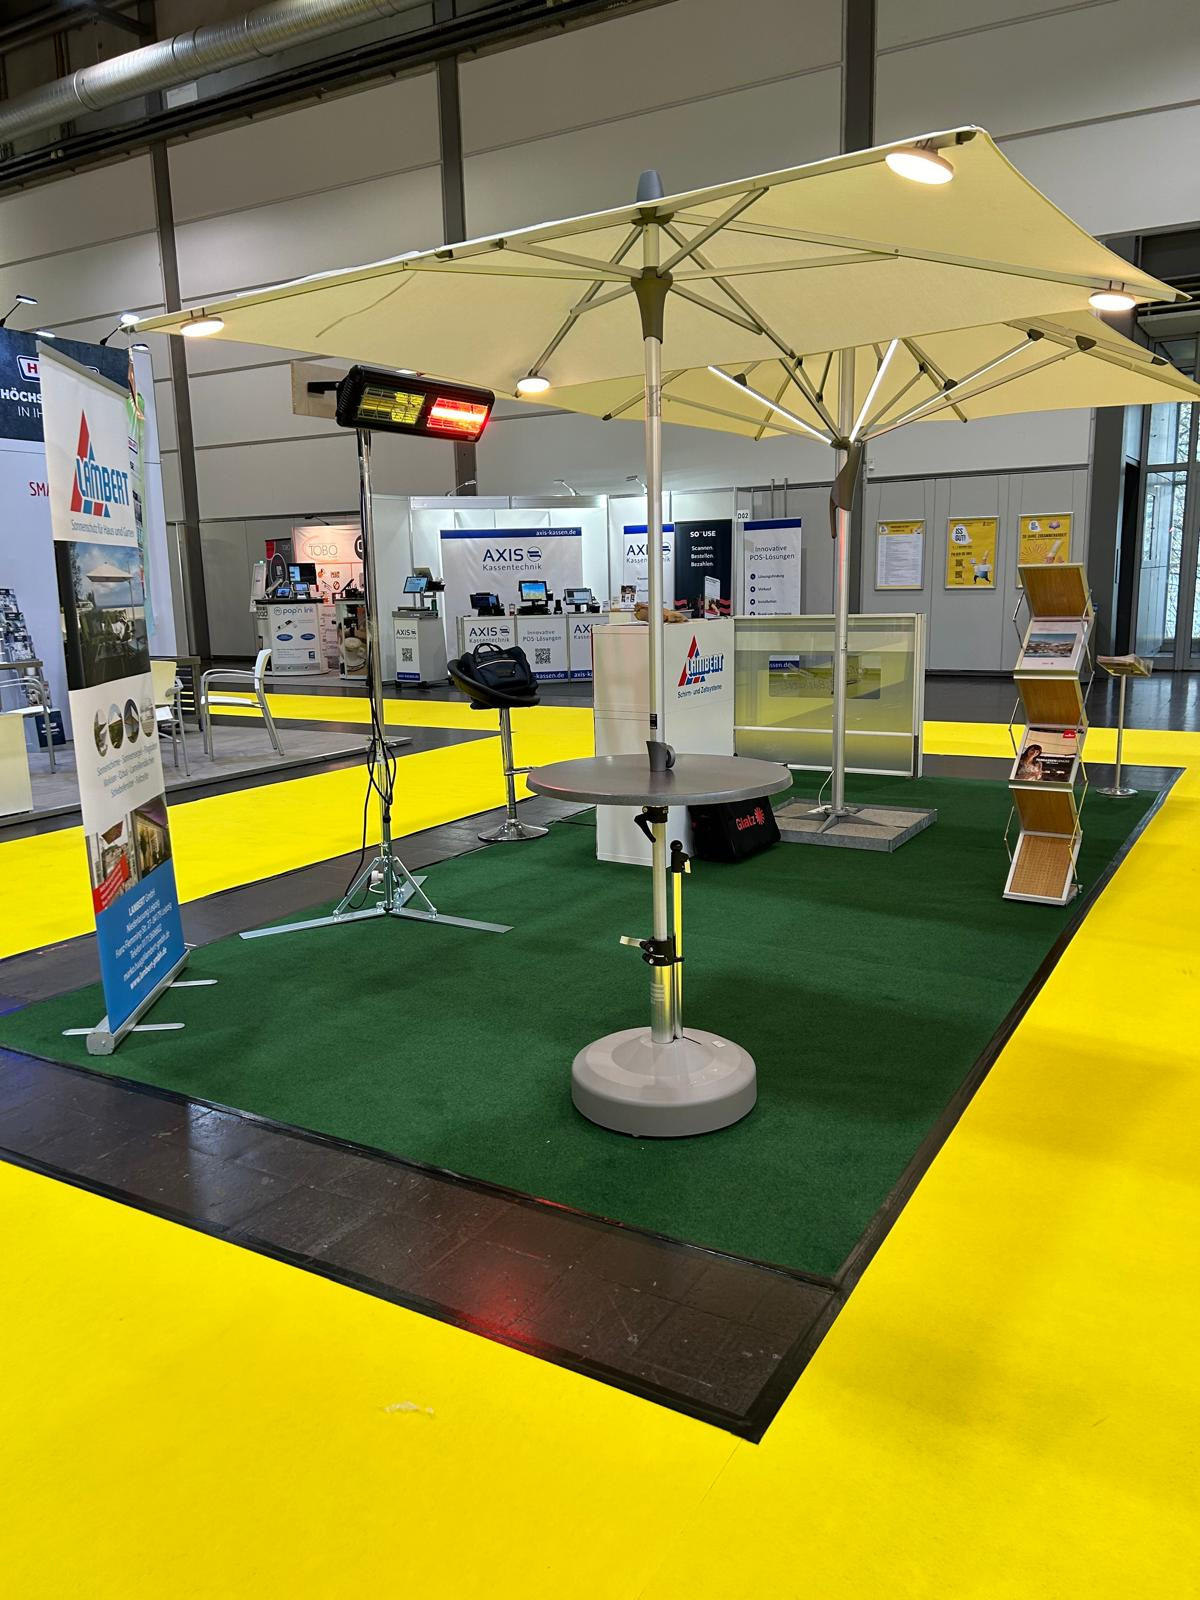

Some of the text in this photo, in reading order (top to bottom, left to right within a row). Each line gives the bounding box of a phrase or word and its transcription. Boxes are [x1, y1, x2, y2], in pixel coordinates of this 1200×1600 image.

[0, 387, 43, 404] HÖCHS
[18, 405, 30, 417] IN
[76, 457, 130, 506] LAMBERT
[535, 529, 577, 537] axis-kassen.de
[308, 543, 338, 557] TOBO
[482, 548, 524, 562] AXIS
[749, 552, 796, 561] POS-Lösungen
[482, 562, 542, 571] Kassentechnik
[469, 626, 498, 637] AXIS
[469, 636, 510, 644] Kassentechnik
[686, 653, 724, 677] LAMBERT
[735, 815, 757, 831] Glatz
